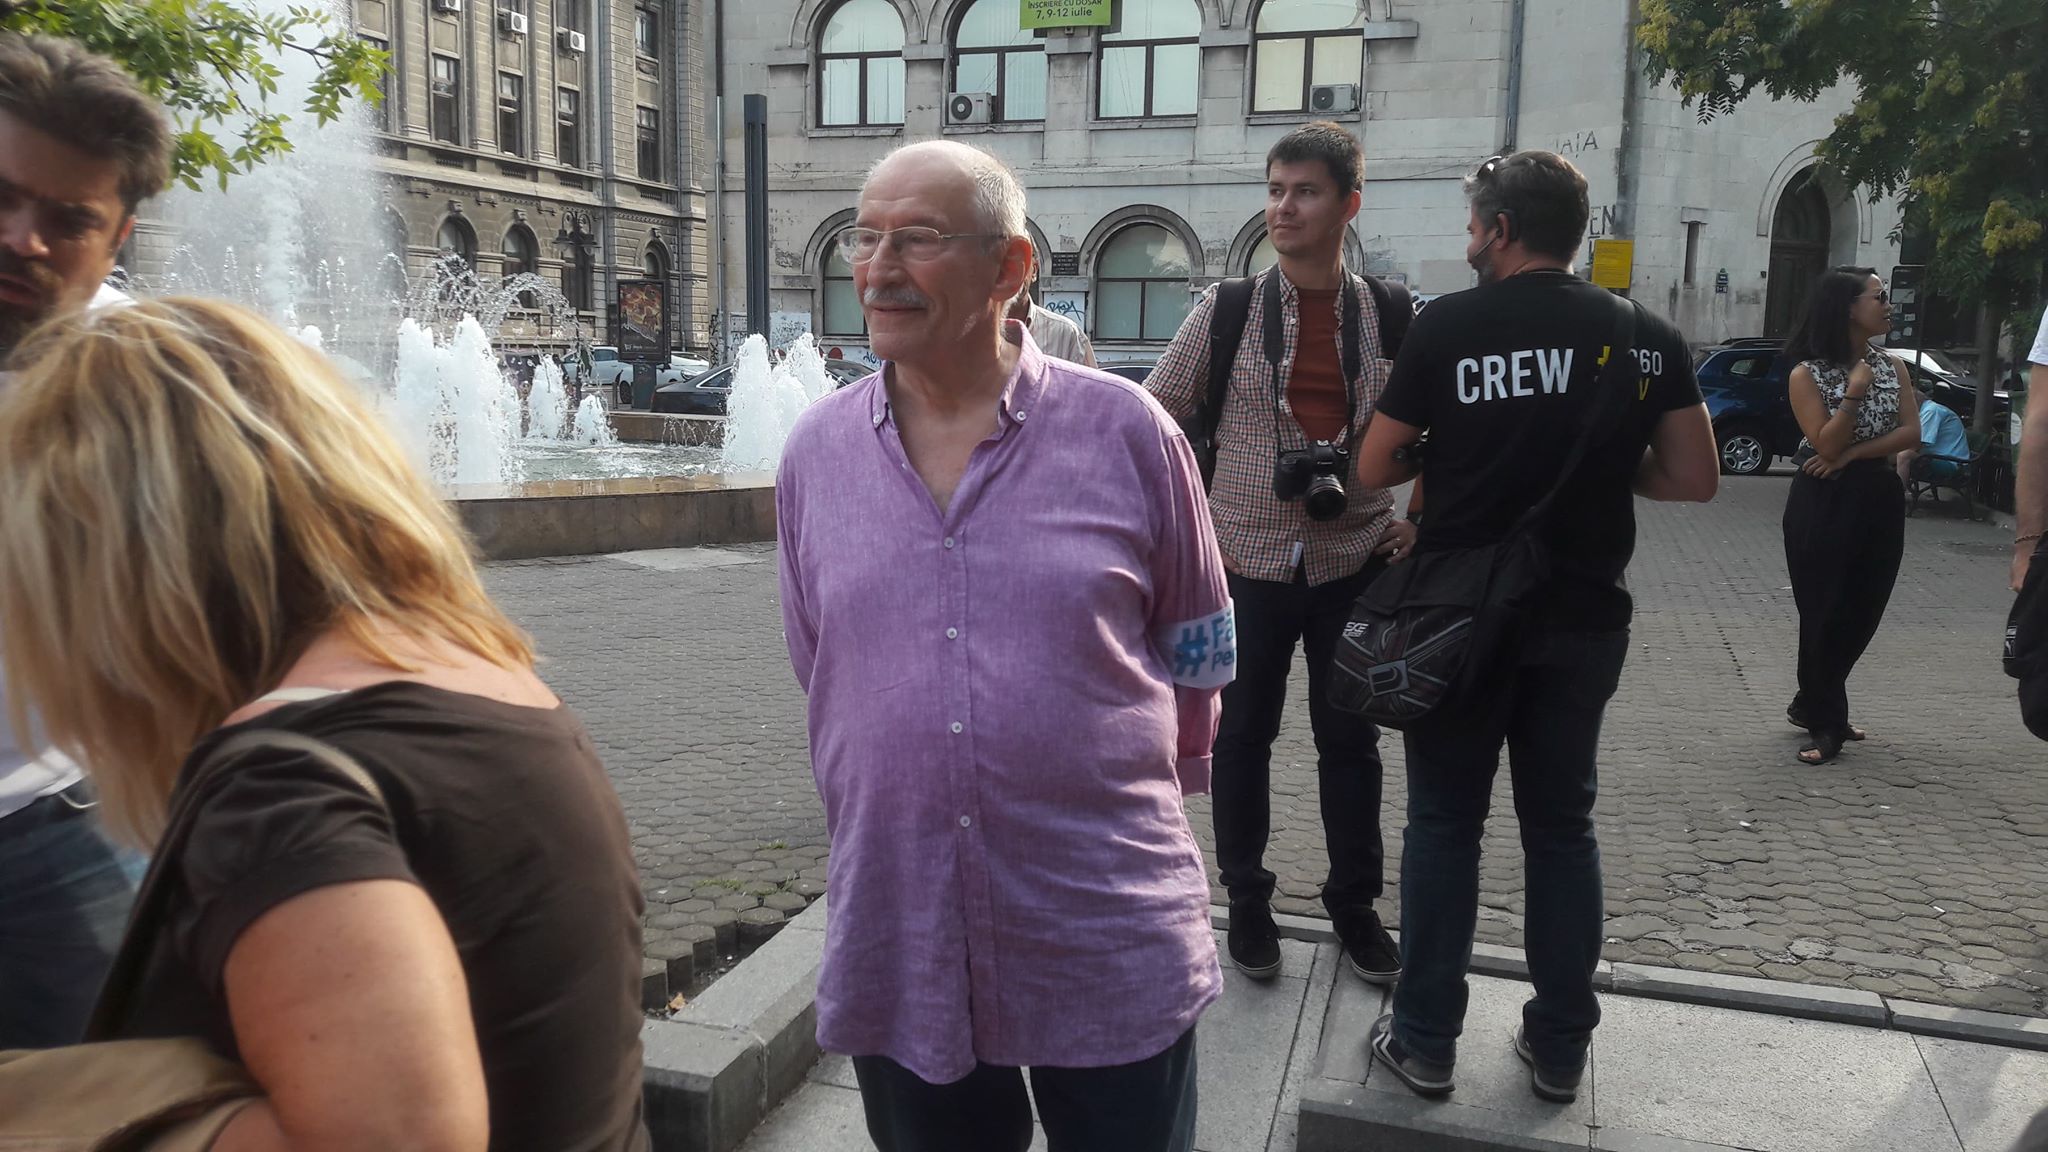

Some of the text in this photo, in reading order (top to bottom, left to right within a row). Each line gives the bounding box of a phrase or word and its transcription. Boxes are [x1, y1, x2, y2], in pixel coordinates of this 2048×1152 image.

[1036, 7, 1093, 20] 7, 9-12 iulie
[1456, 348, 1574, 404] CREW
